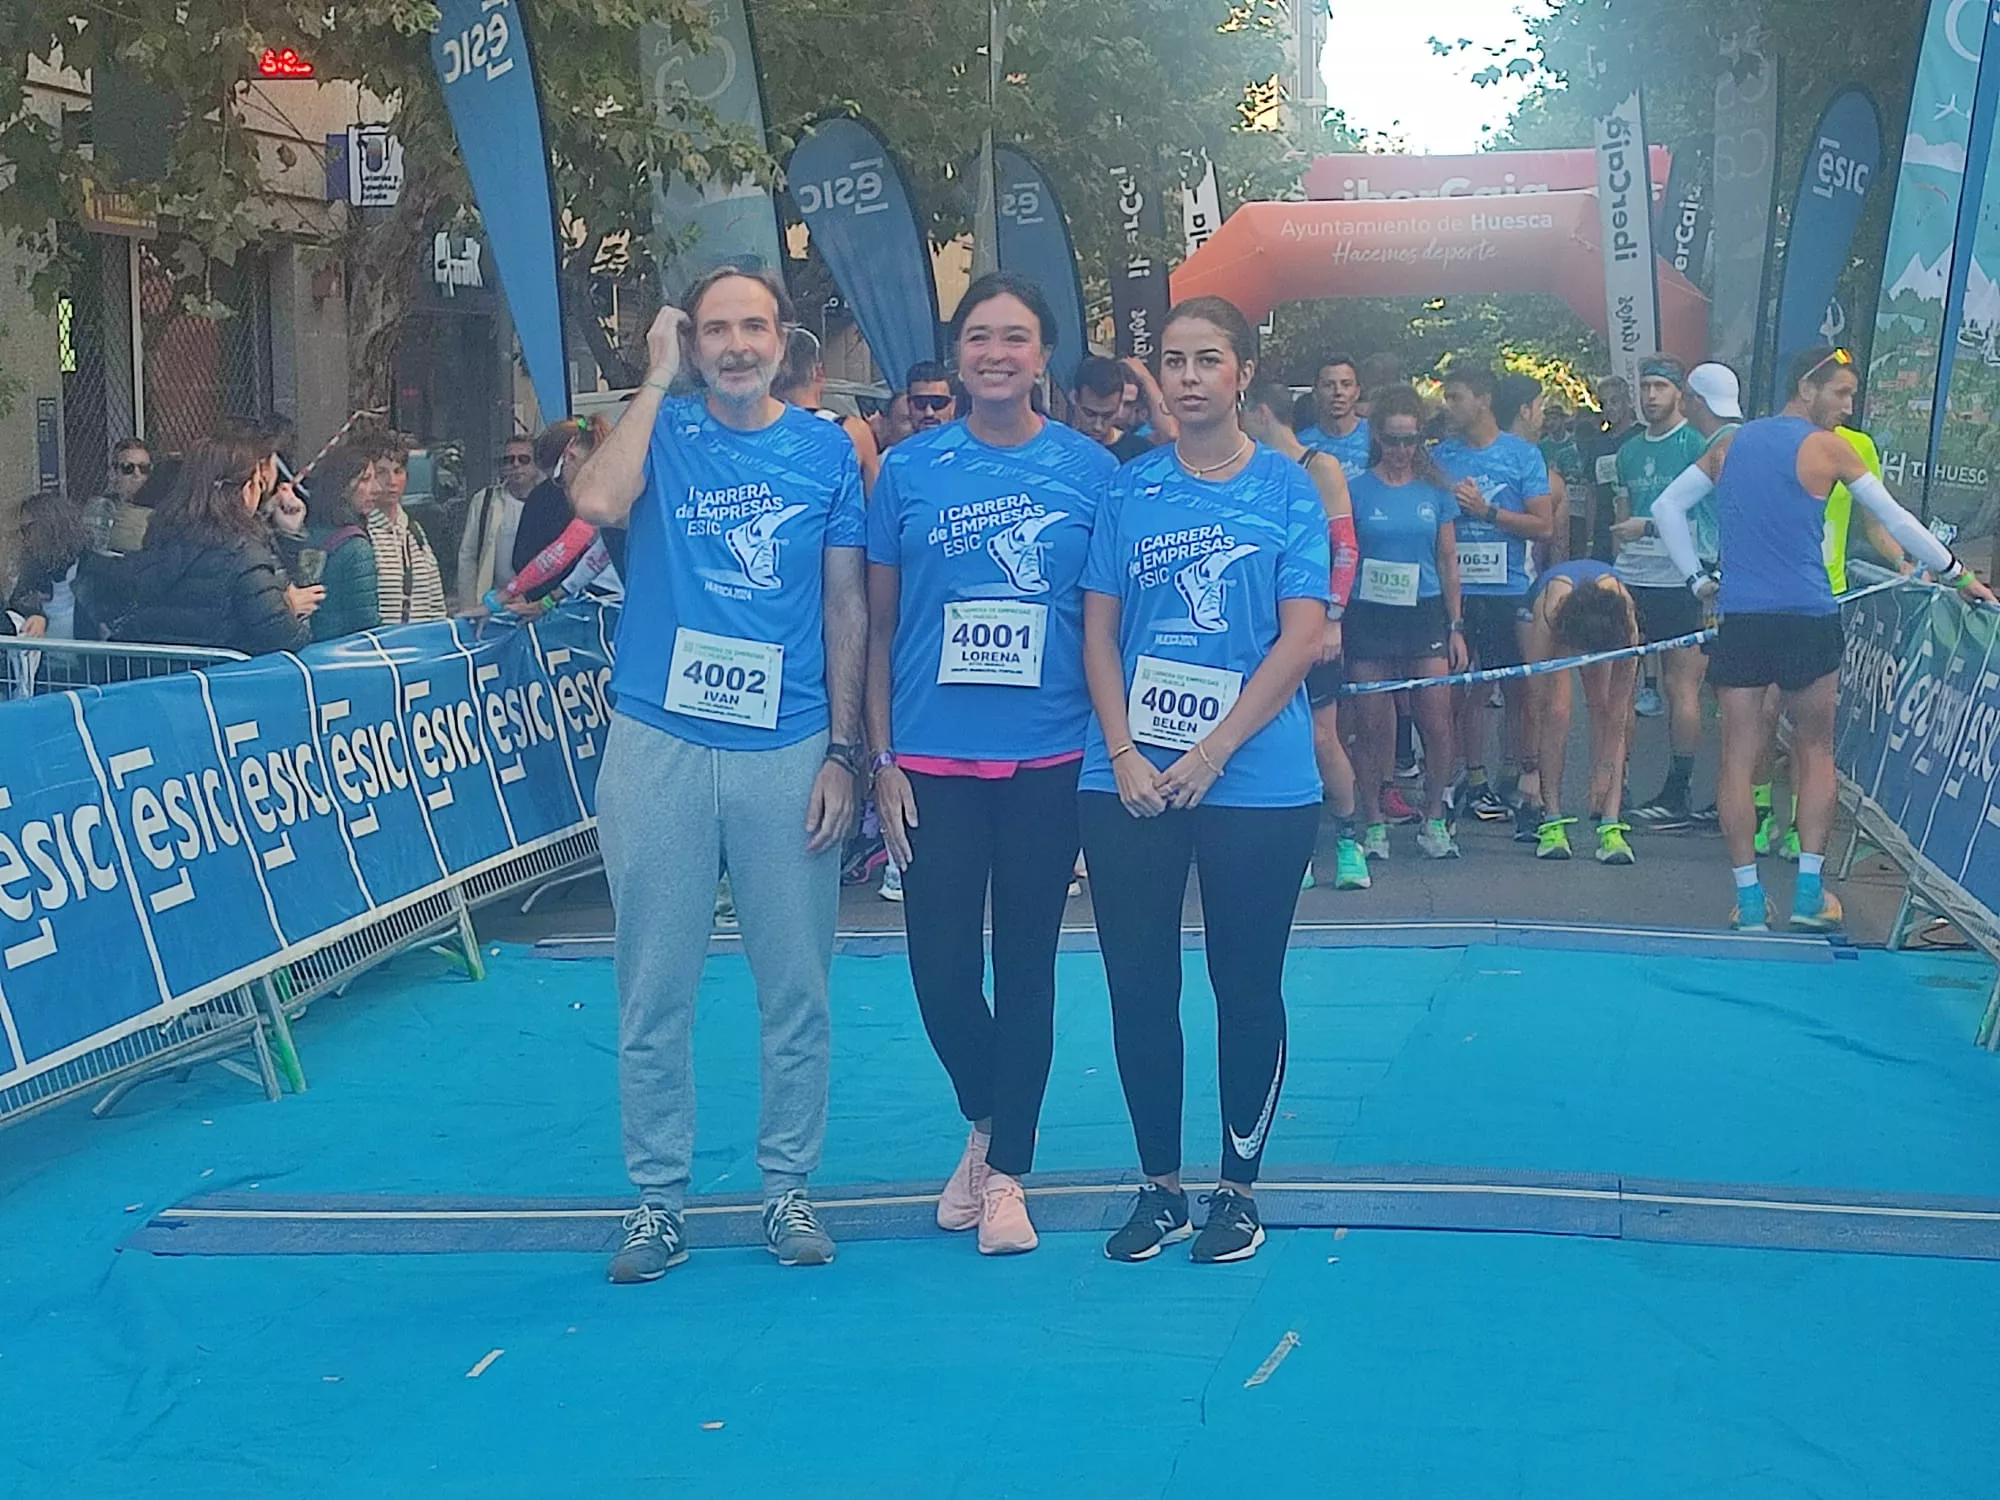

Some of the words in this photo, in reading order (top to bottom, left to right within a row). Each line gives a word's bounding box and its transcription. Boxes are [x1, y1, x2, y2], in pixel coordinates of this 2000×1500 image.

[1818, 150, 1870, 196] esic
[1280, 215, 1432, 241] Ayuntamiento
[1437, 214, 1463, 233] de
[1470, 211, 1553, 231] Huesca
[1332, 240, 1417, 266] Hacemos
[1421, 237, 1497, 270] deporte
[697, 496, 784, 520] EMPRESAS
[948, 493, 1032, 521] CARRERA
[687, 520, 721, 536] ESIC
[928, 527, 948, 546] de
[951, 504, 1046, 538] EMPRESAS
[1140, 523, 1224, 552] CARRERA
[943, 534, 982, 558] ESIC
[1142, 536, 1236, 568] EMPRESAS
[1370, 570, 1410, 587] 3035
[951, 623, 1031, 650] 4001
[961, 651, 1021, 664] LORENA
[683, 660, 767, 695] 4002
[558, 667, 613, 732] esic
[704, 690, 740, 705] IVAN
[1141, 686, 1220, 722] 4000
[486, 681, 554, 754] esic
[413, 701, 481, 779] esic
[331, 721, 409, 803] esic
[241, 744, 331, 833] esic
[132, 769, 240, 870] esic
[0, 804, 119, 921] esic
